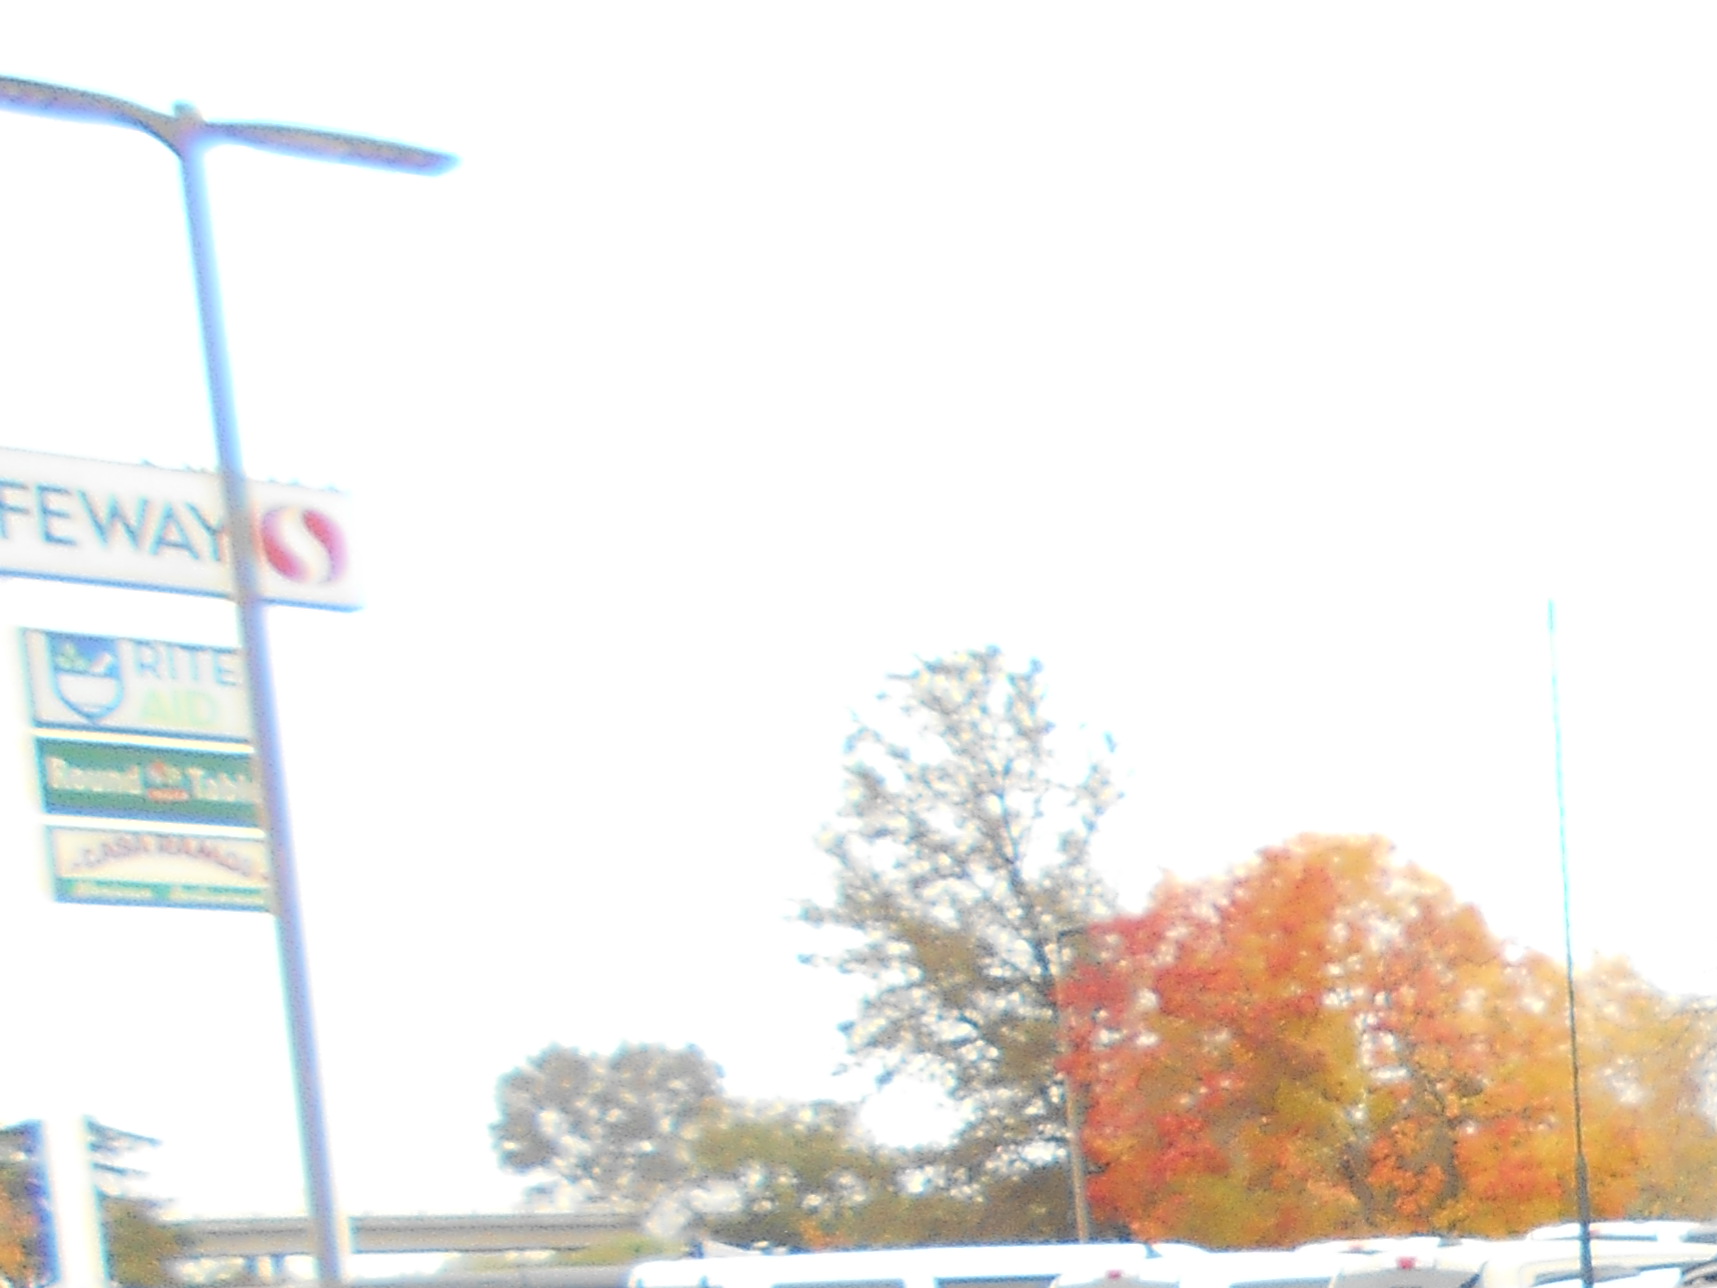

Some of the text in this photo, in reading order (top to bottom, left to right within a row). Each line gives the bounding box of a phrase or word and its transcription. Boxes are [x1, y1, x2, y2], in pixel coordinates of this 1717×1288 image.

[135, 645, 241, 686] RITE
[139, 686, 218, 728] AID
[46, 756, 140, 795] Round
